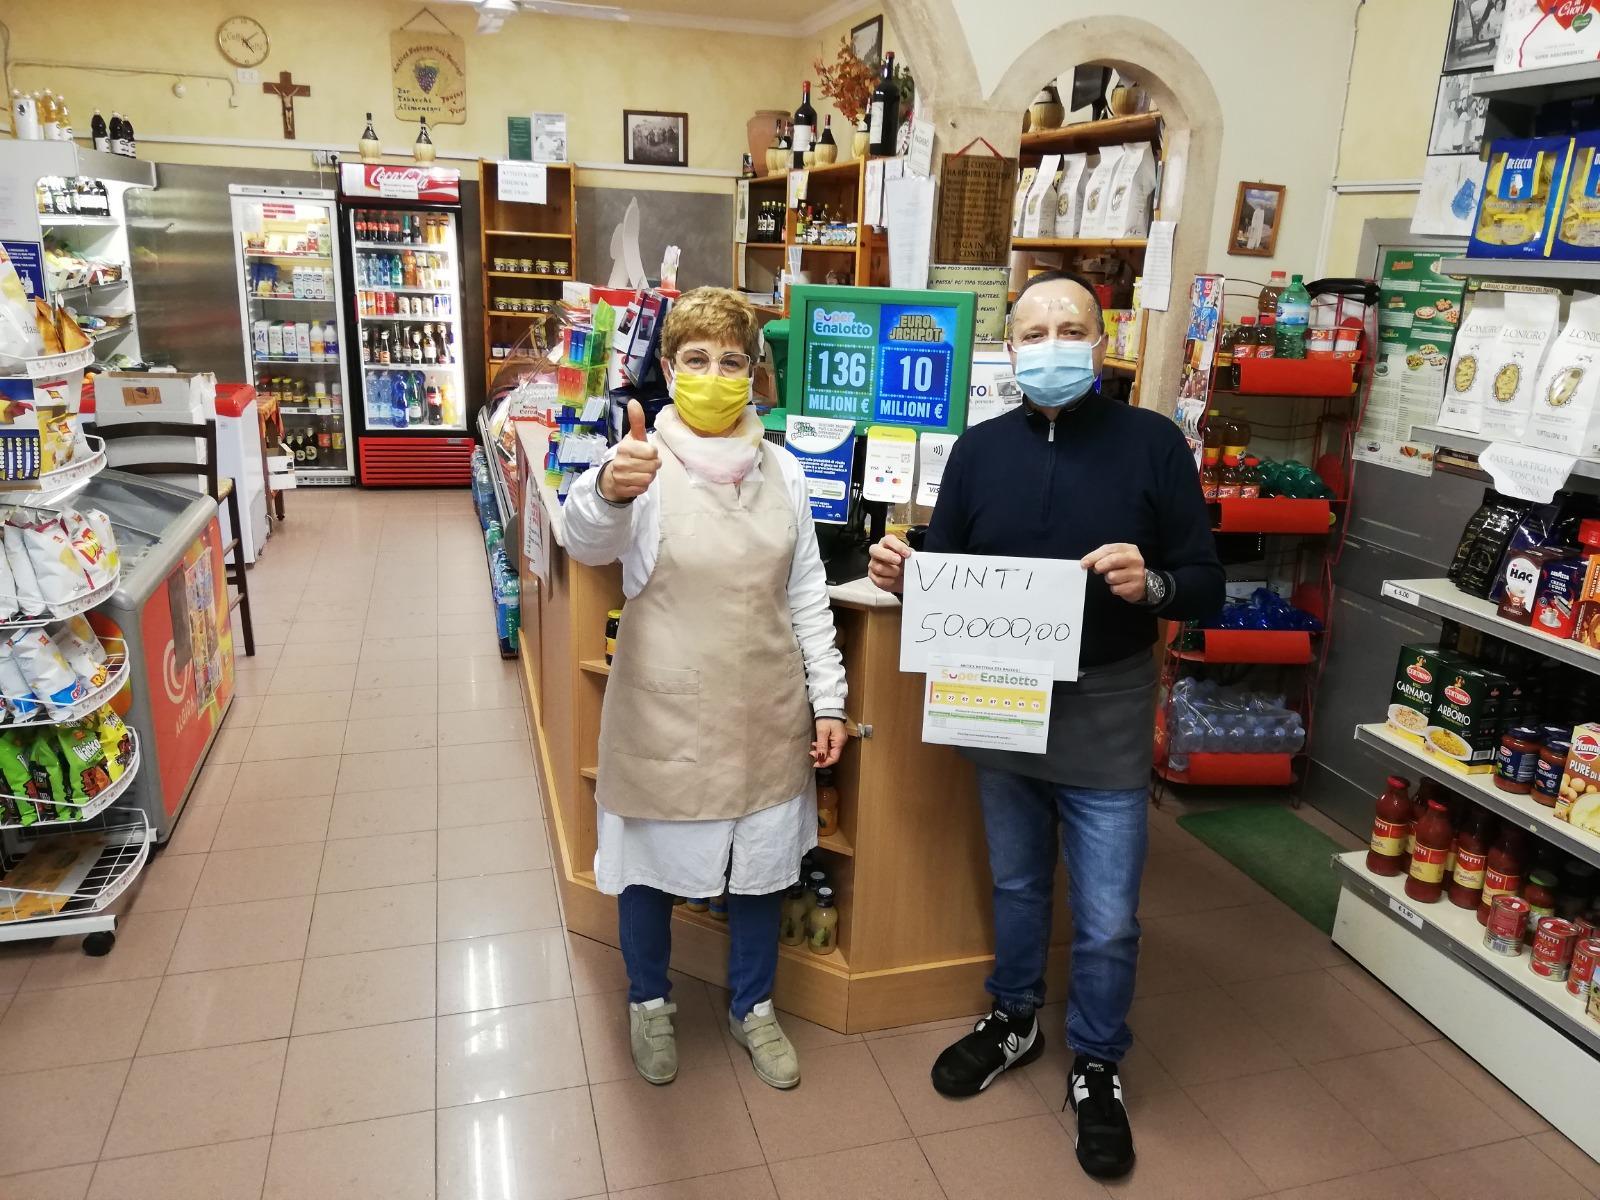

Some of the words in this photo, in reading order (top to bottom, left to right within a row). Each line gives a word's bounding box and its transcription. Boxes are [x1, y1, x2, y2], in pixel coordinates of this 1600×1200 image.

[953, 241, 973, 250] PAGA
[900, 314, 932, 328] EURO
[815, 322, 871, 336] Enalotto
[889, 327, 943, 342] JACKPOT
[1464, 323, 1500, 334] LONIGRO
[1502, 327, 1547, 341] LONIGRO
[818, 350, 866, 387] 136
[899, 355, 933, 392] 10
[808, 394, 857, 413] MILIONI
[860, 398, 870, 414] €
[880, 399, 931, 419] MILIONI
[934, 403, 943, 419] €
[1510, 470, 1550, 487] TOSCANA
[929, 486, 941, 494] VIS
[915, 559, 1033, 592] VINTI
[1509, 567, 1534, 584] HAG
[1550, 570, 1570, 580] LAVAZZA
[1550, 579, 1566, 588] CREMA
[1551, 584, 1567, 593] GUSTO
[915, 612, 1071, 646] 50.000,00
[1396, 680, 1433, 704] CARNAROL
[175, 695, 195, 739] ALGIDA
[1437, 703, 1471, 726] ARBORIO
[1459, 852, 1481, 865] MUTTI
[1486, 872, 1503, 883] UTTI
[1538, 931, 1560, 945] MUTTI
